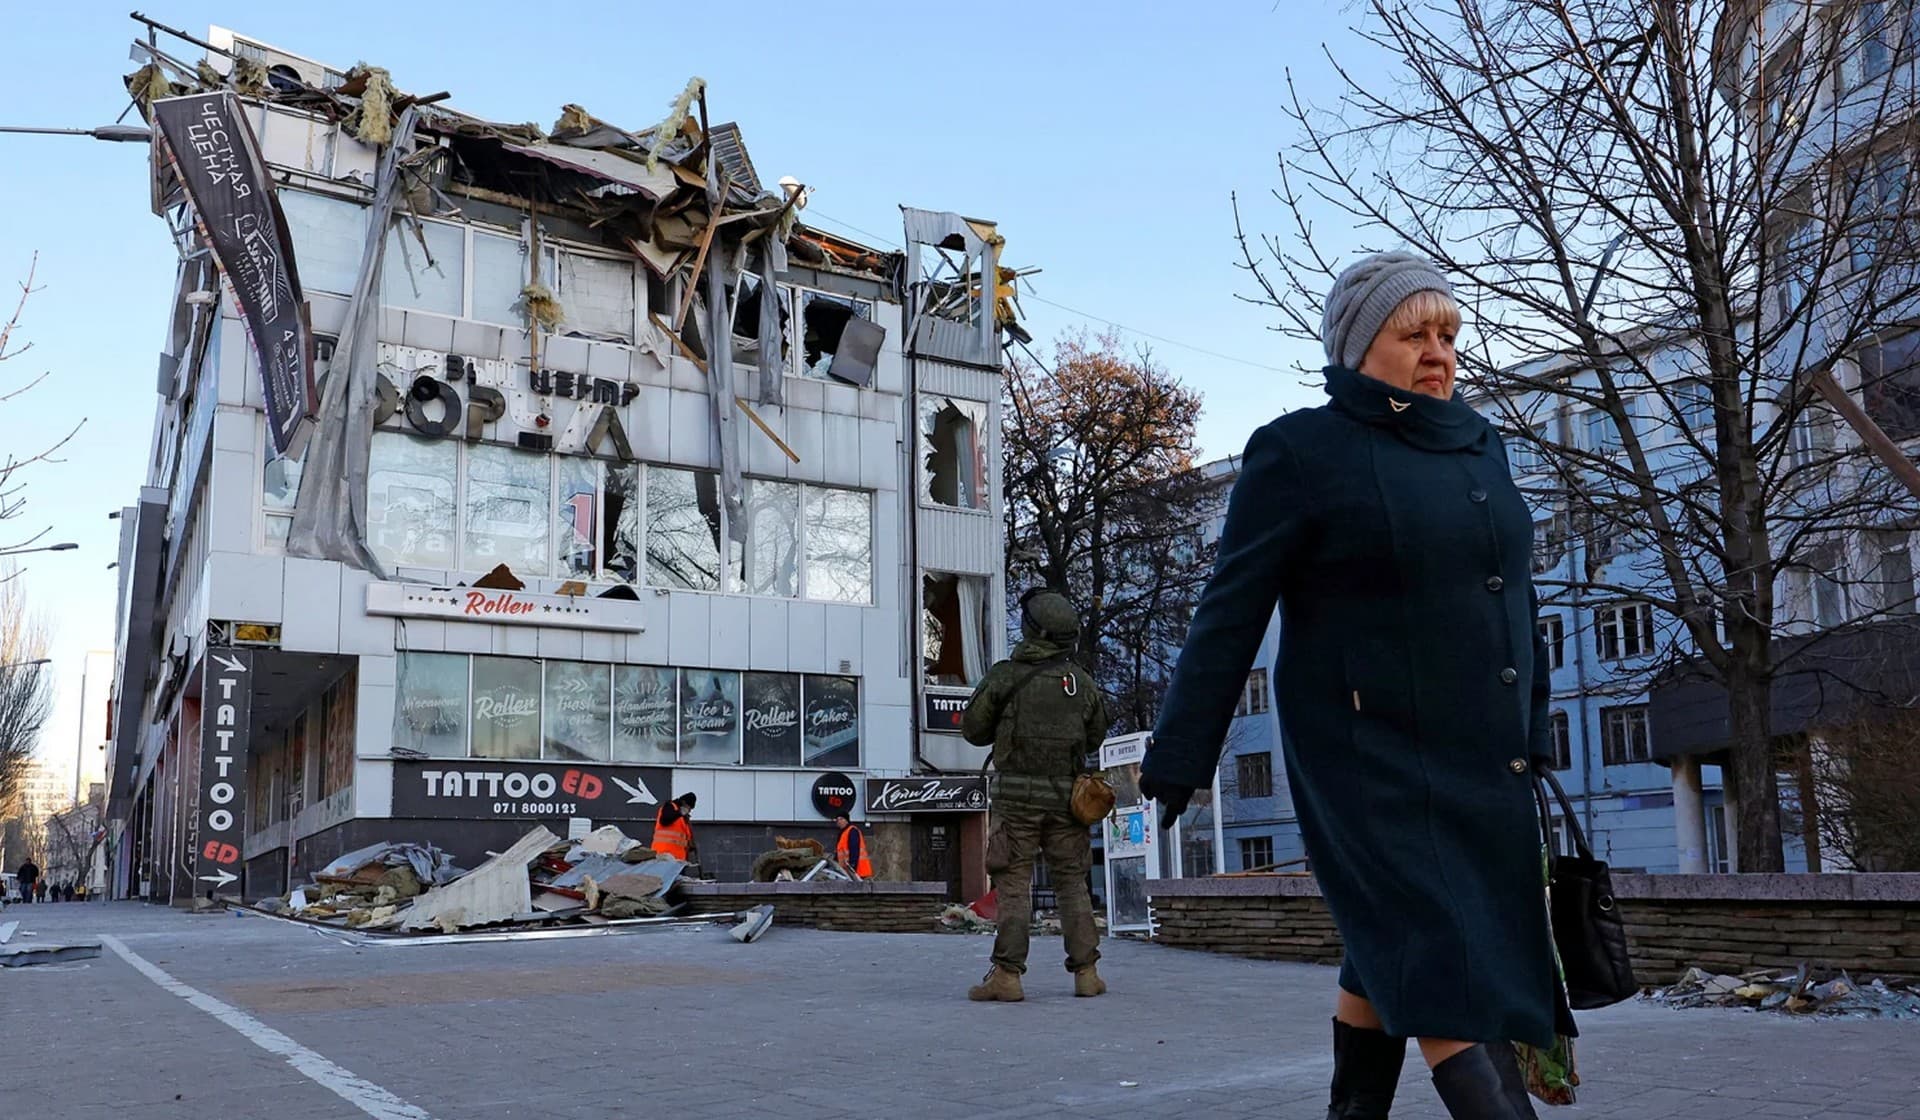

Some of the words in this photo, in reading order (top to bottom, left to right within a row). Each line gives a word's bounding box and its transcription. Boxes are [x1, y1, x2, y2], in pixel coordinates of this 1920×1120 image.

[188, 125, 226, 185] ЦЕНА
[201, 102, 251, 199] ЧЕСТНАЯ
[697, 702, 718, 718] Ice
[933, 698, 969, 711] TATTO
[686, 717, 726, 730] cream
[812, 709, 848, 726] Cakes
[208, 679, 237, 831] TATTOO
[422, 770, 557, 798] TATTOO
[561, 769, 604, 799] ED
[818, 786, 853, 796] TATTOO
[493, 802, 516, 814] 071
[203, 840, 239, 864] ED
